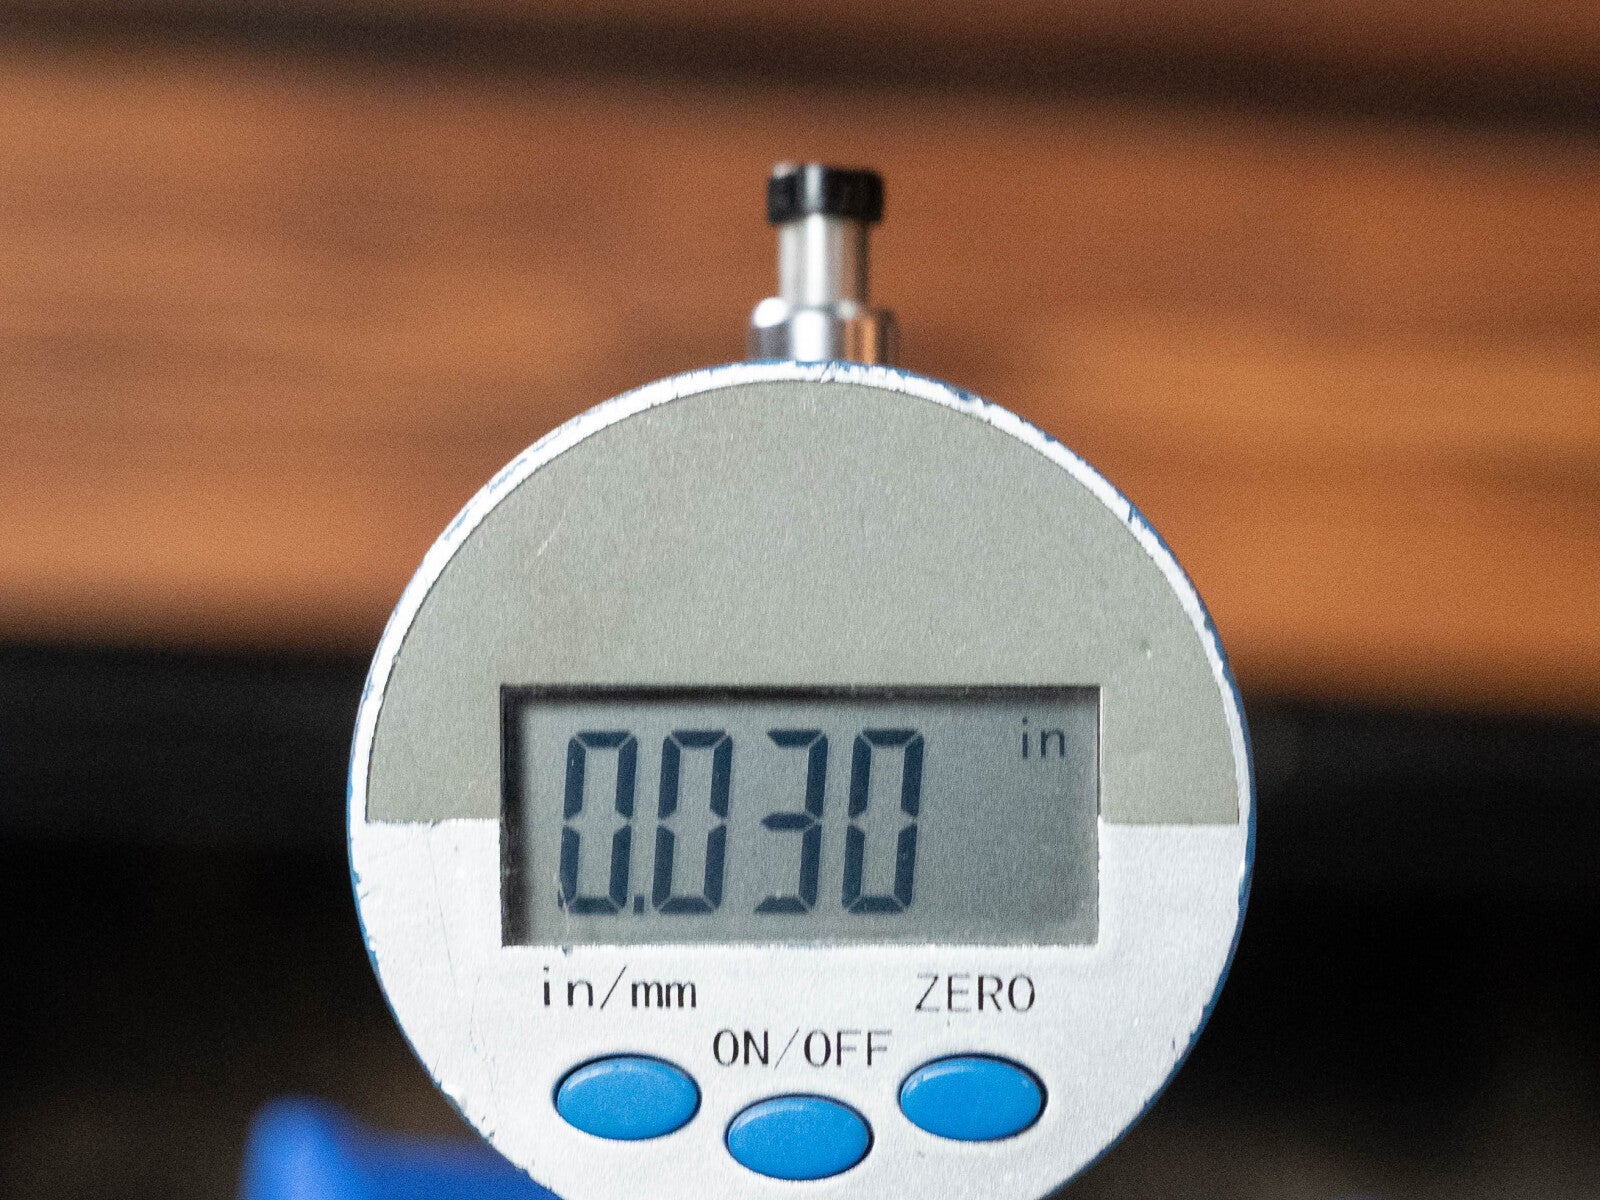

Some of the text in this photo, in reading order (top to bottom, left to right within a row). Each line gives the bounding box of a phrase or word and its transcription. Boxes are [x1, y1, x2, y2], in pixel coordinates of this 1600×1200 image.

[1020, 717, 1066, 758] in
[559, 729, 924, 914] 0.030
[542, 965, 698, 1009] in/mm
[914, 973, 1036, 1012] ZERO
[712, 1028, 892, 1067] ON/OFF
